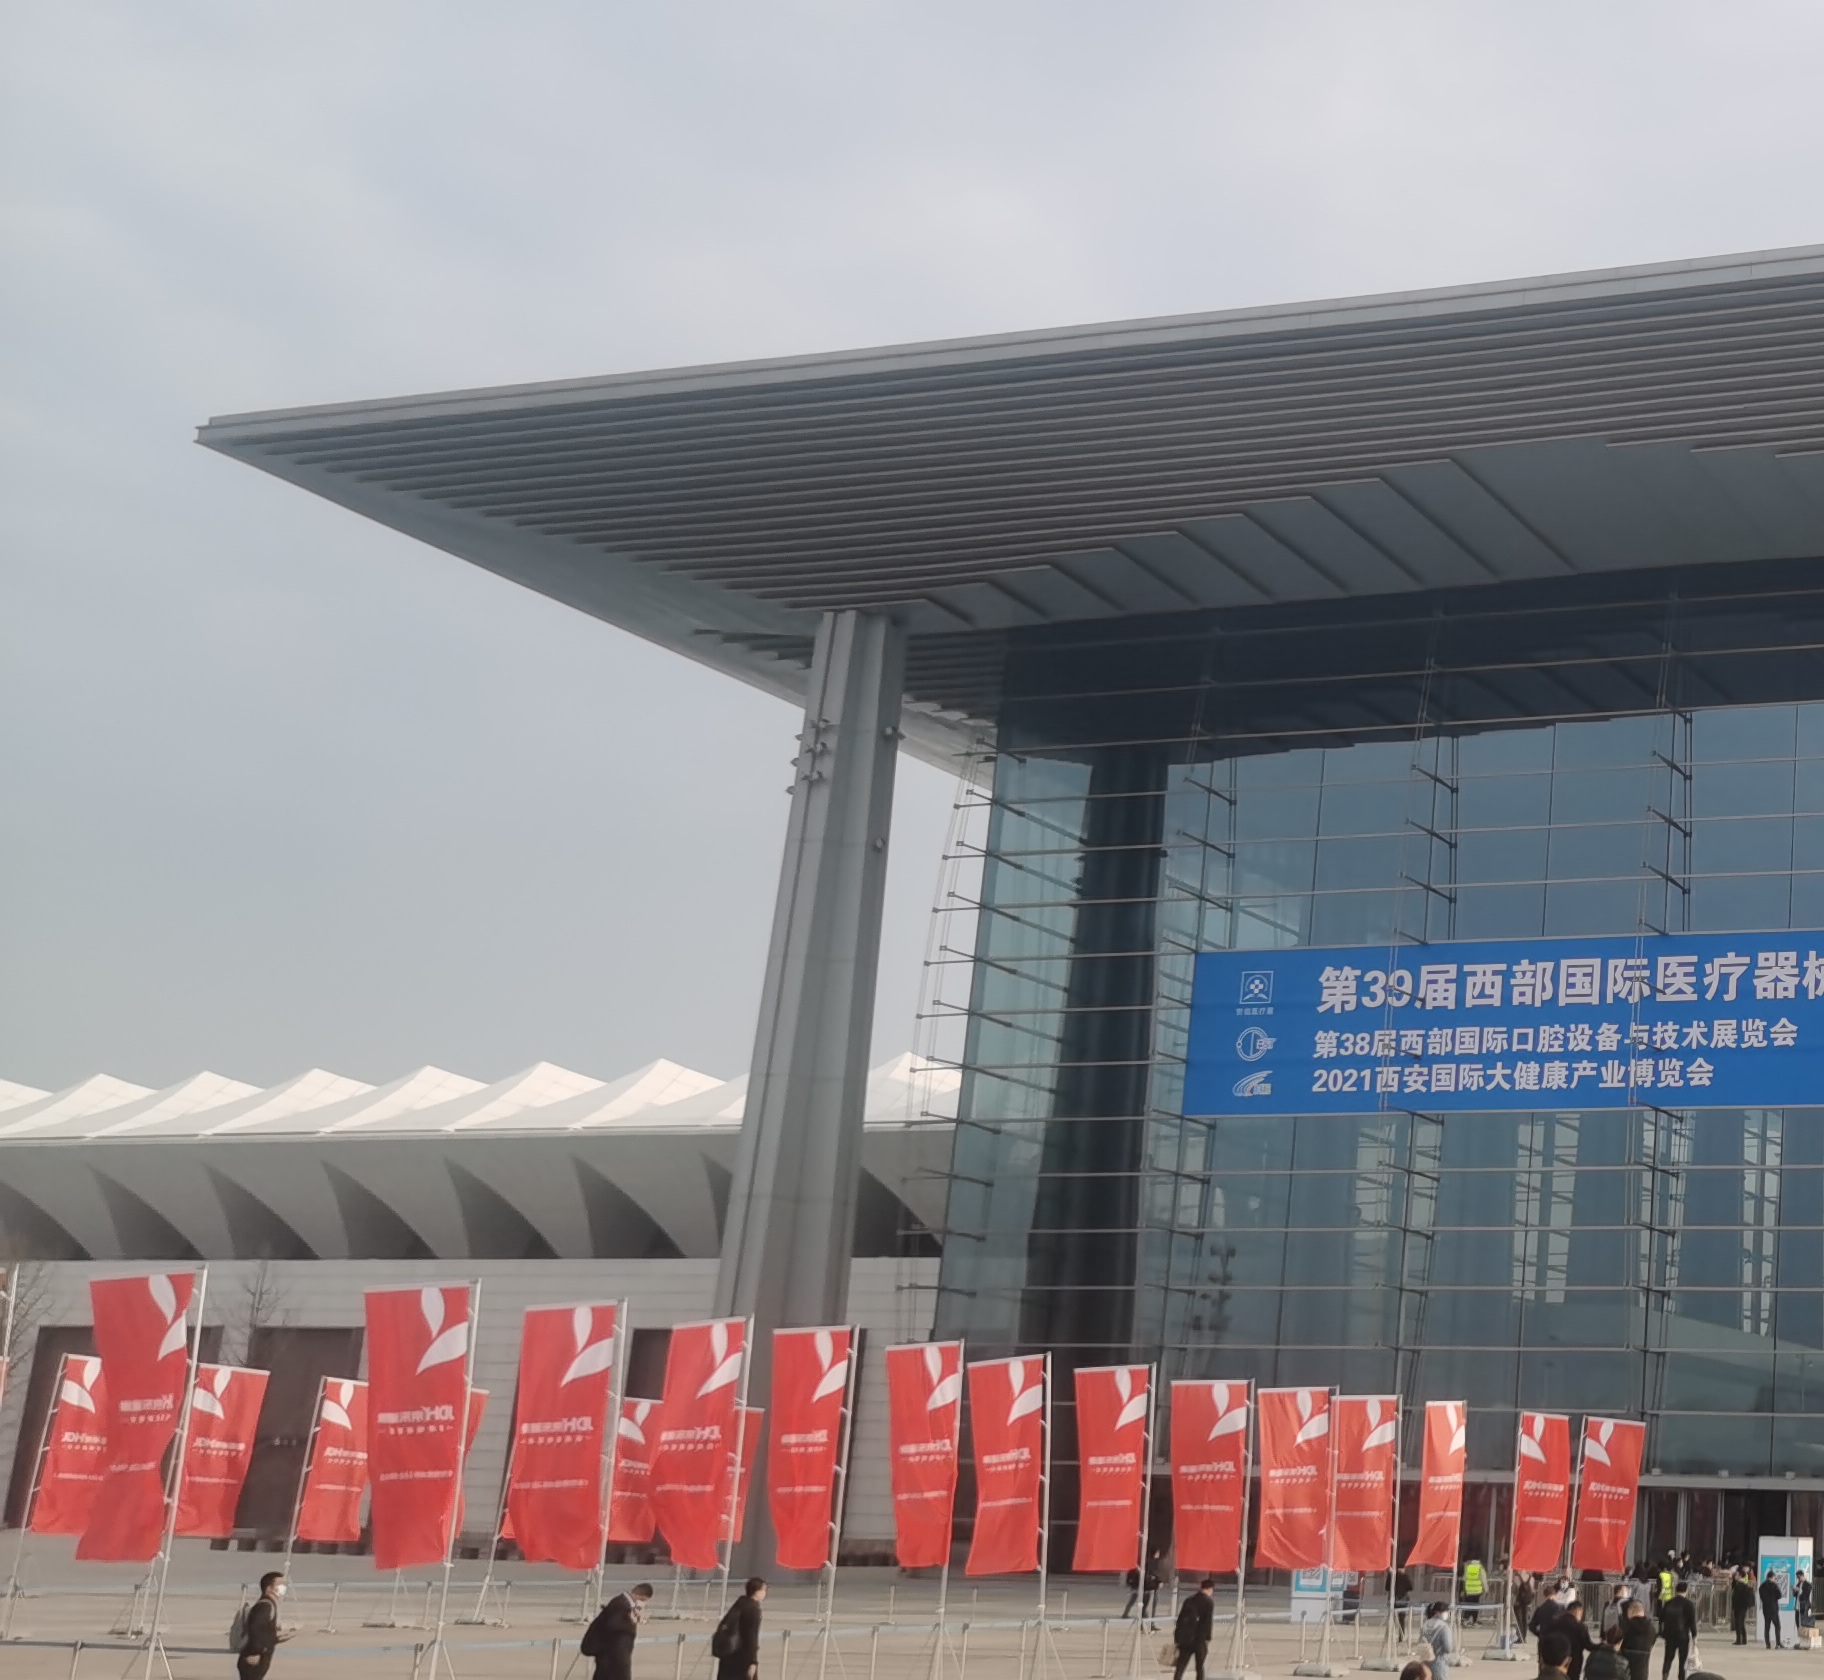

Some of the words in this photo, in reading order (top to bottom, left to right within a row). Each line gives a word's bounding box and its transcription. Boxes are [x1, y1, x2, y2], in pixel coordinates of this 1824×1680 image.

[1313, 1017, 1798, 1058] 第38届西部国际口腔设备与技术展览会
[1312, 1057, 1714, 1093] 2021西安国际大健康产业博览会
